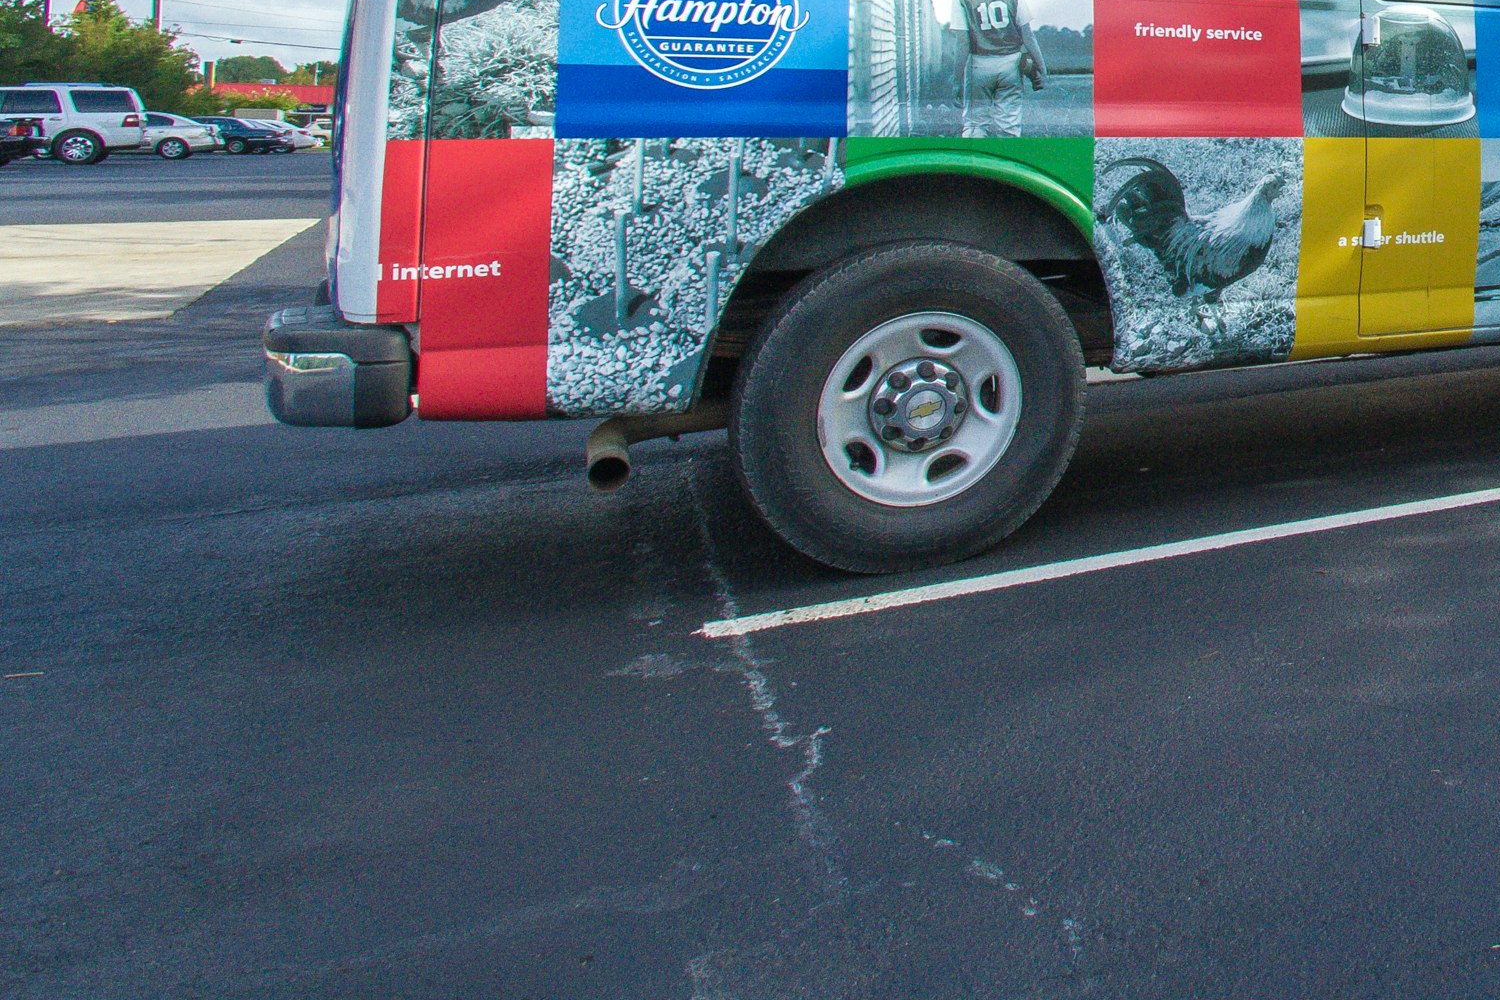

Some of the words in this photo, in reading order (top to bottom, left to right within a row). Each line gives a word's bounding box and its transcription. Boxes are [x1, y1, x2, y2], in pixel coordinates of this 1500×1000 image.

[976, 0, 1010, 31] 10
[1134, 22, 1201, 42] friendly
[1206, 27, 1263, 41] service
[628, 31, 697, 82] SATISFACTION
[659, 41, 755, 54] GUARANTEE
[719, 35, 786, 82] SATISFACTION
[1338, 236, 1347, 247] a
[1351, 234, 1392, 247] suer
[1395, 230, 1445, 245] shuttle
[392, 260, 502, 281] internet
